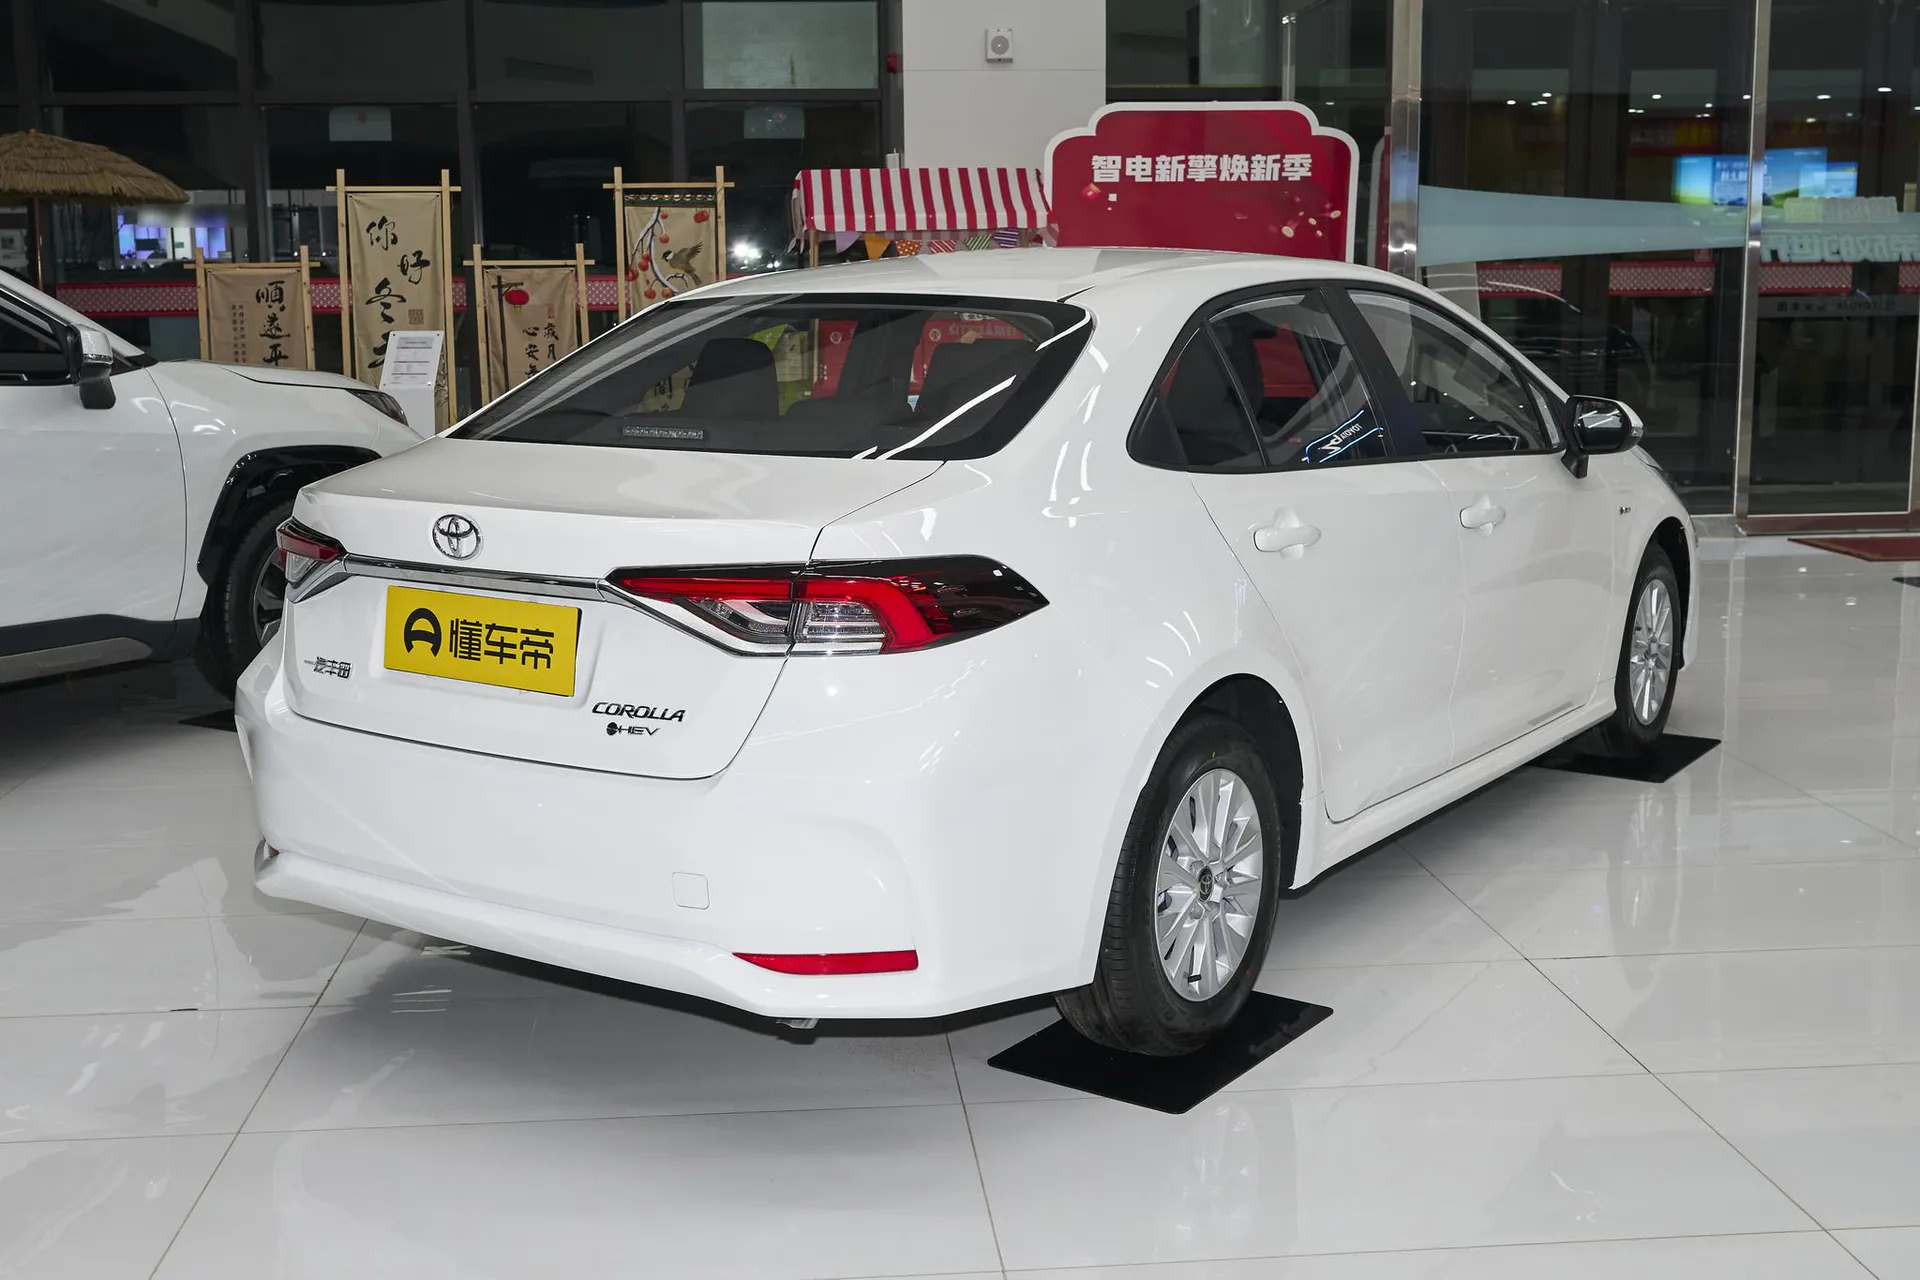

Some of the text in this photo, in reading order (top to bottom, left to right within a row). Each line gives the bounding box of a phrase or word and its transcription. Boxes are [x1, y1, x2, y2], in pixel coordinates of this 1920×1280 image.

[1091, 153, 1312, 183] 智电新擎焕新季
[448, 618, 555, 670] 懂车帝
[592, 702, 686, 722] COROLLA
[617, 725, 661, 736] HEV
